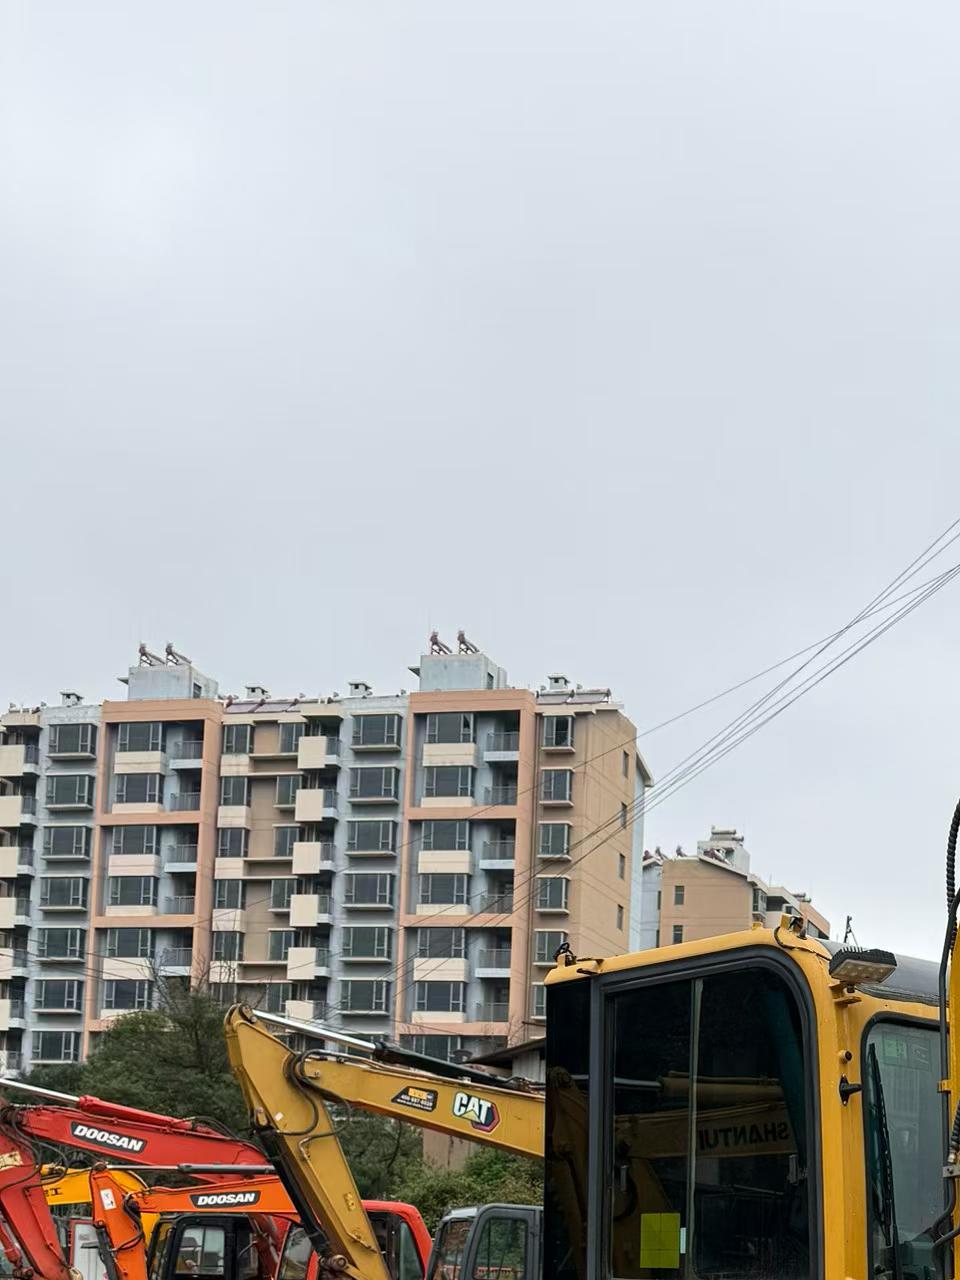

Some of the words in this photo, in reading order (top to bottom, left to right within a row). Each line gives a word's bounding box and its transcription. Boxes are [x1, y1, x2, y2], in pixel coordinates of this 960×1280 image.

[454, 1091, 492, 1124] CAT
[73, 1124, 144, 1152] DOOSAN
[197, 1192, 256, 1206] DOOSAN
